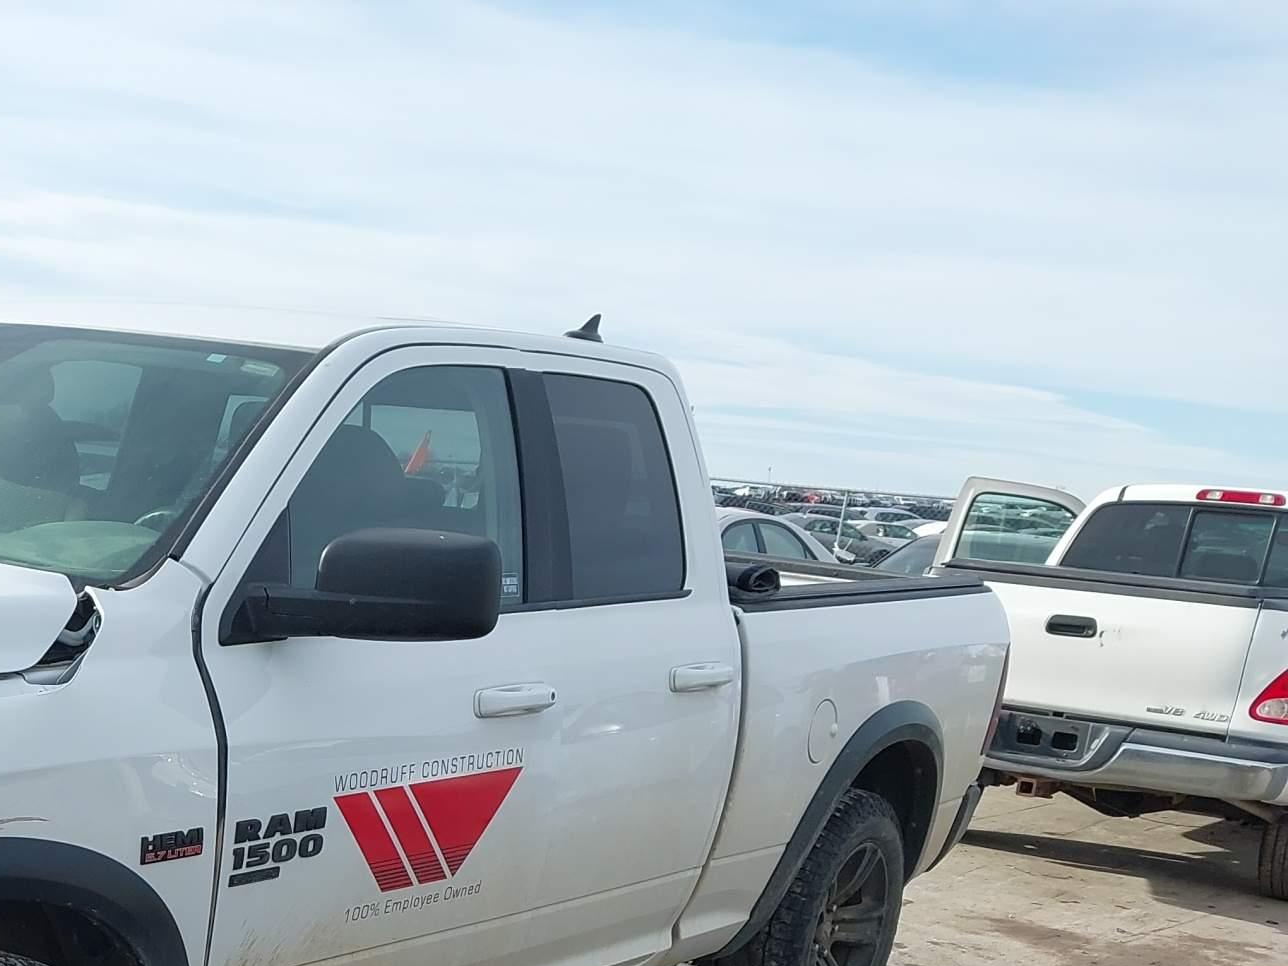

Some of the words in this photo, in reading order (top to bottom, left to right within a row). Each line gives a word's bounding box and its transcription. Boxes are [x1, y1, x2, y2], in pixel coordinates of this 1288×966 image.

[1192, 710, 1230, 723] 4WD
[334, 763, 416, 793] WOODRUFF
[421, 747, 524, 779] CONSTRUCTION
[141, 827, 203, 852] HEMI
[234, 806, 327, 844] RAM
[145, 850, 166, 863] 5.7
[167, 845, 202, 859] LITER
[232, 833, 324, 870] 1500
[344, 902, 380, 924] 100%
[383, 891, 440, 915] Employee
[443, 879, 482, 902] Owned
